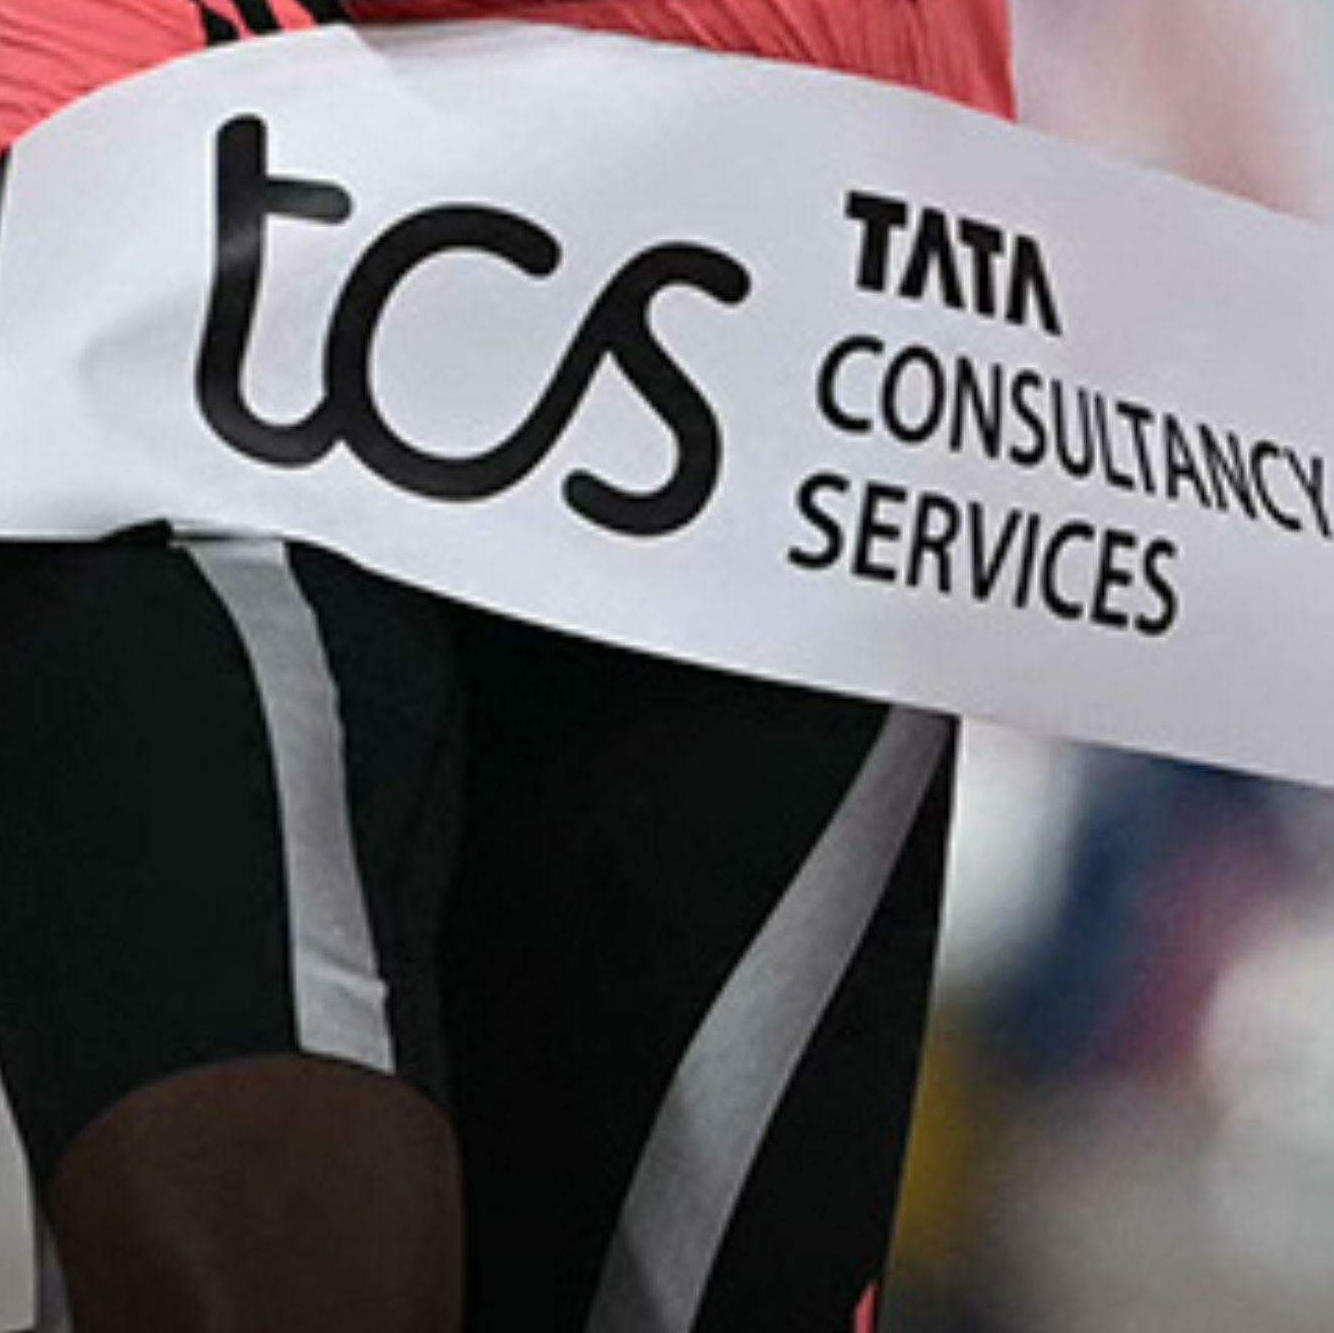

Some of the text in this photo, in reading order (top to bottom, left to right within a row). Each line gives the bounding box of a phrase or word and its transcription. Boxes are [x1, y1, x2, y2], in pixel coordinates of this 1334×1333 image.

[195, 113, 752, 536] tcs
[845, 191, 1062, 335] TATA
[817, 334, 1333, 538] CONSULTANCY
[787, 472, 1180, 637] SERVICES
